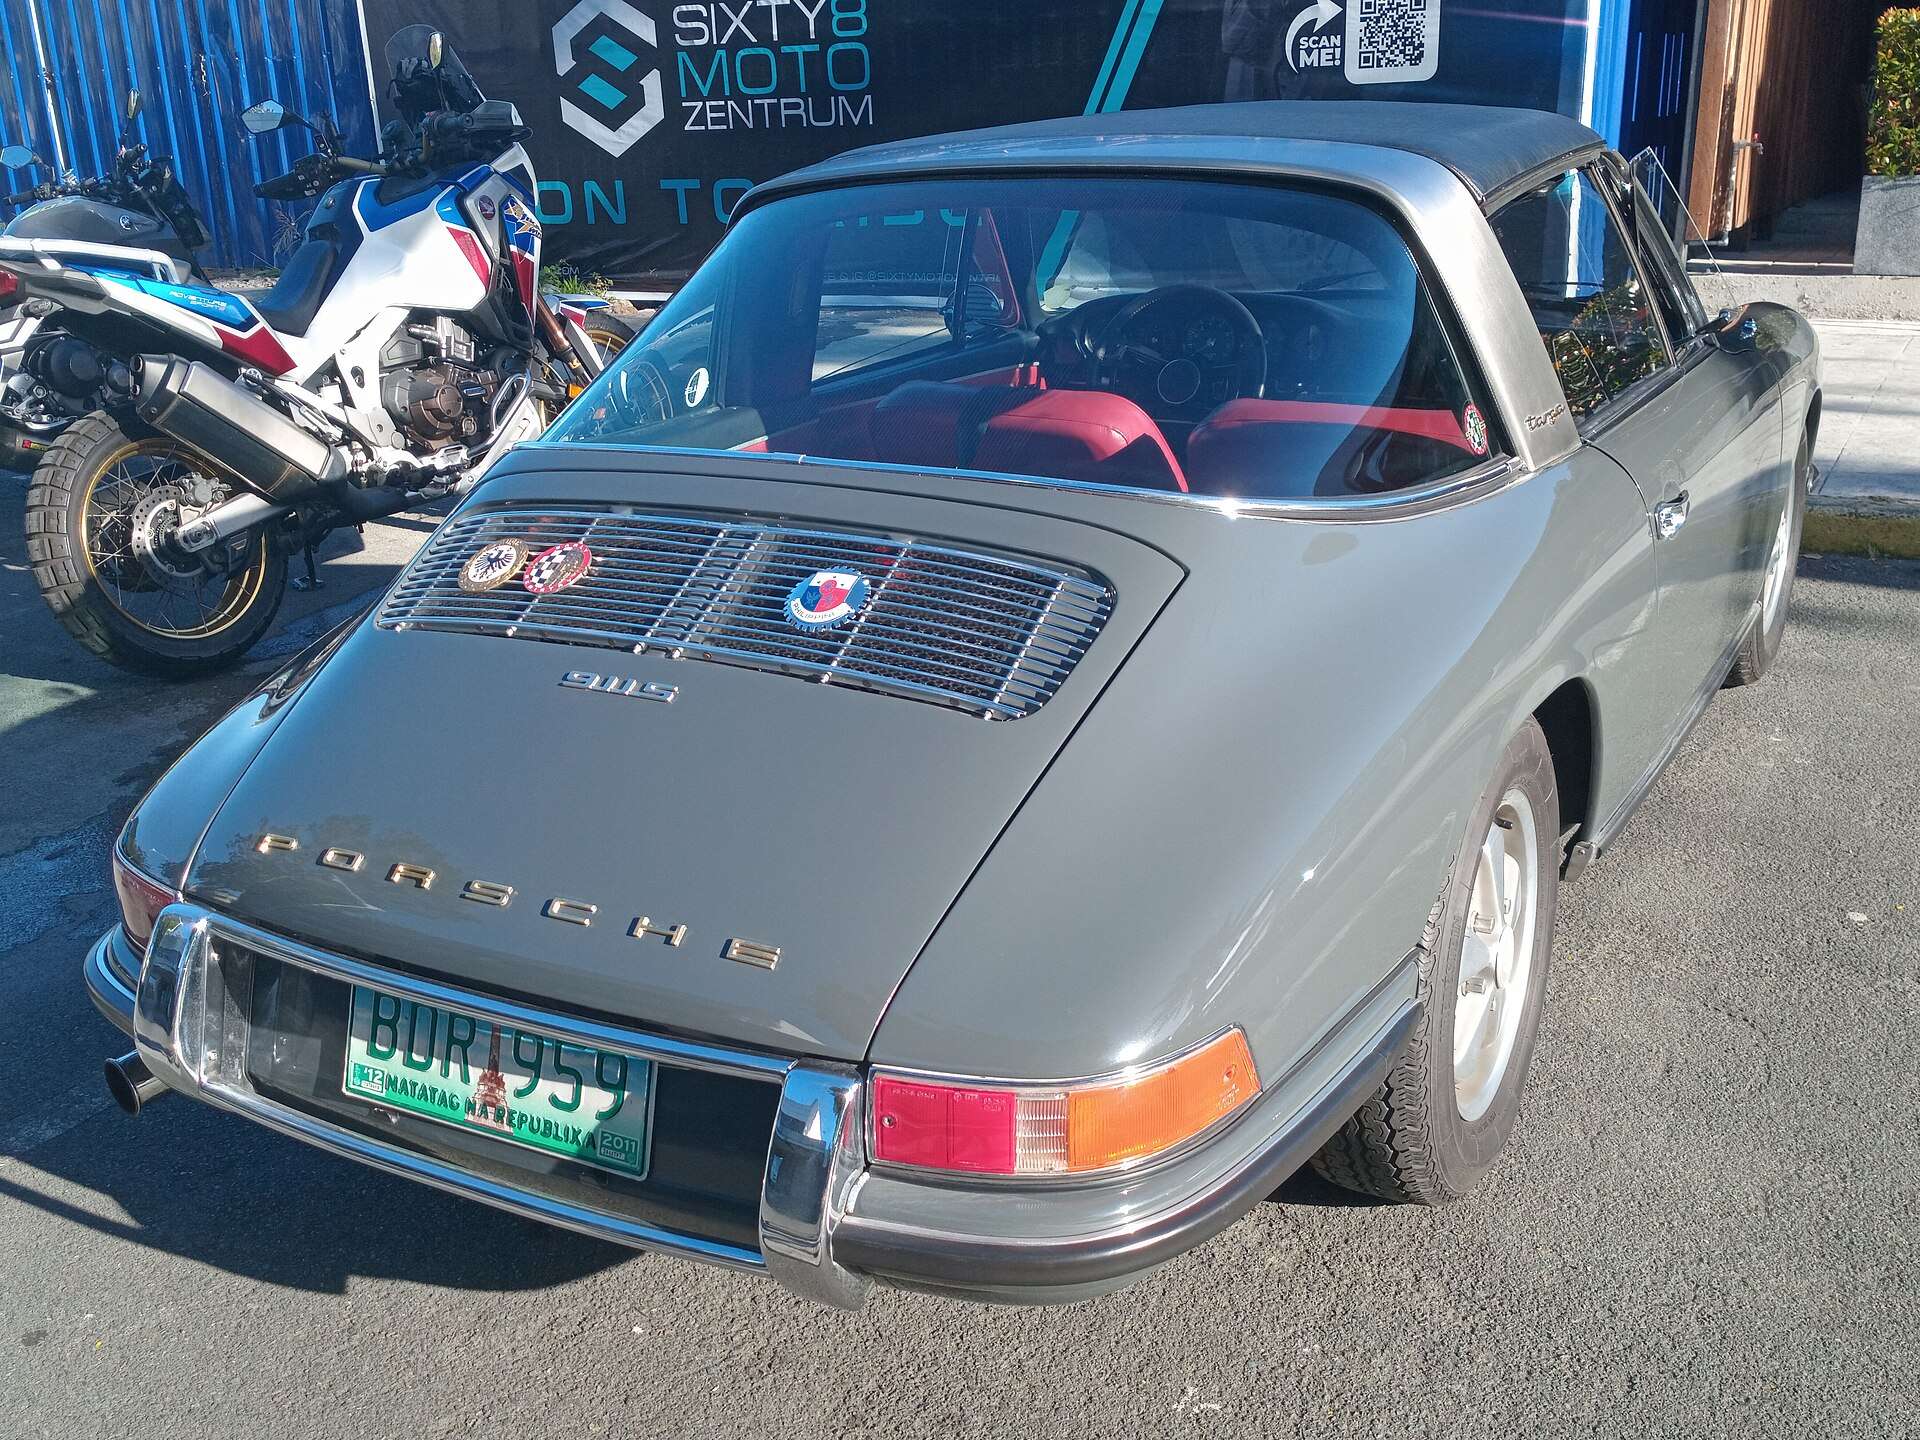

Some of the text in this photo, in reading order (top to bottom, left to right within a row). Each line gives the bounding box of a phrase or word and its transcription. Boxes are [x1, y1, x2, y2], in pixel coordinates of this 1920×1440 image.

[672, 0, 868, 47] SIXTY8
[1299, 35, 1341, 49] SCAN
[676, 42, 871, 98] MOTO
[1299, 47, 1341, 68] ME!
[681, 94, 873, 131] ZENTRUM
[257, 832, 783, 971] PORSCHE
[367, 989, 629, 1121] BDR 959
[493, 1104, 597, 1151] REPUBLIKA
[602, 1133, 636, 1153] 2011
